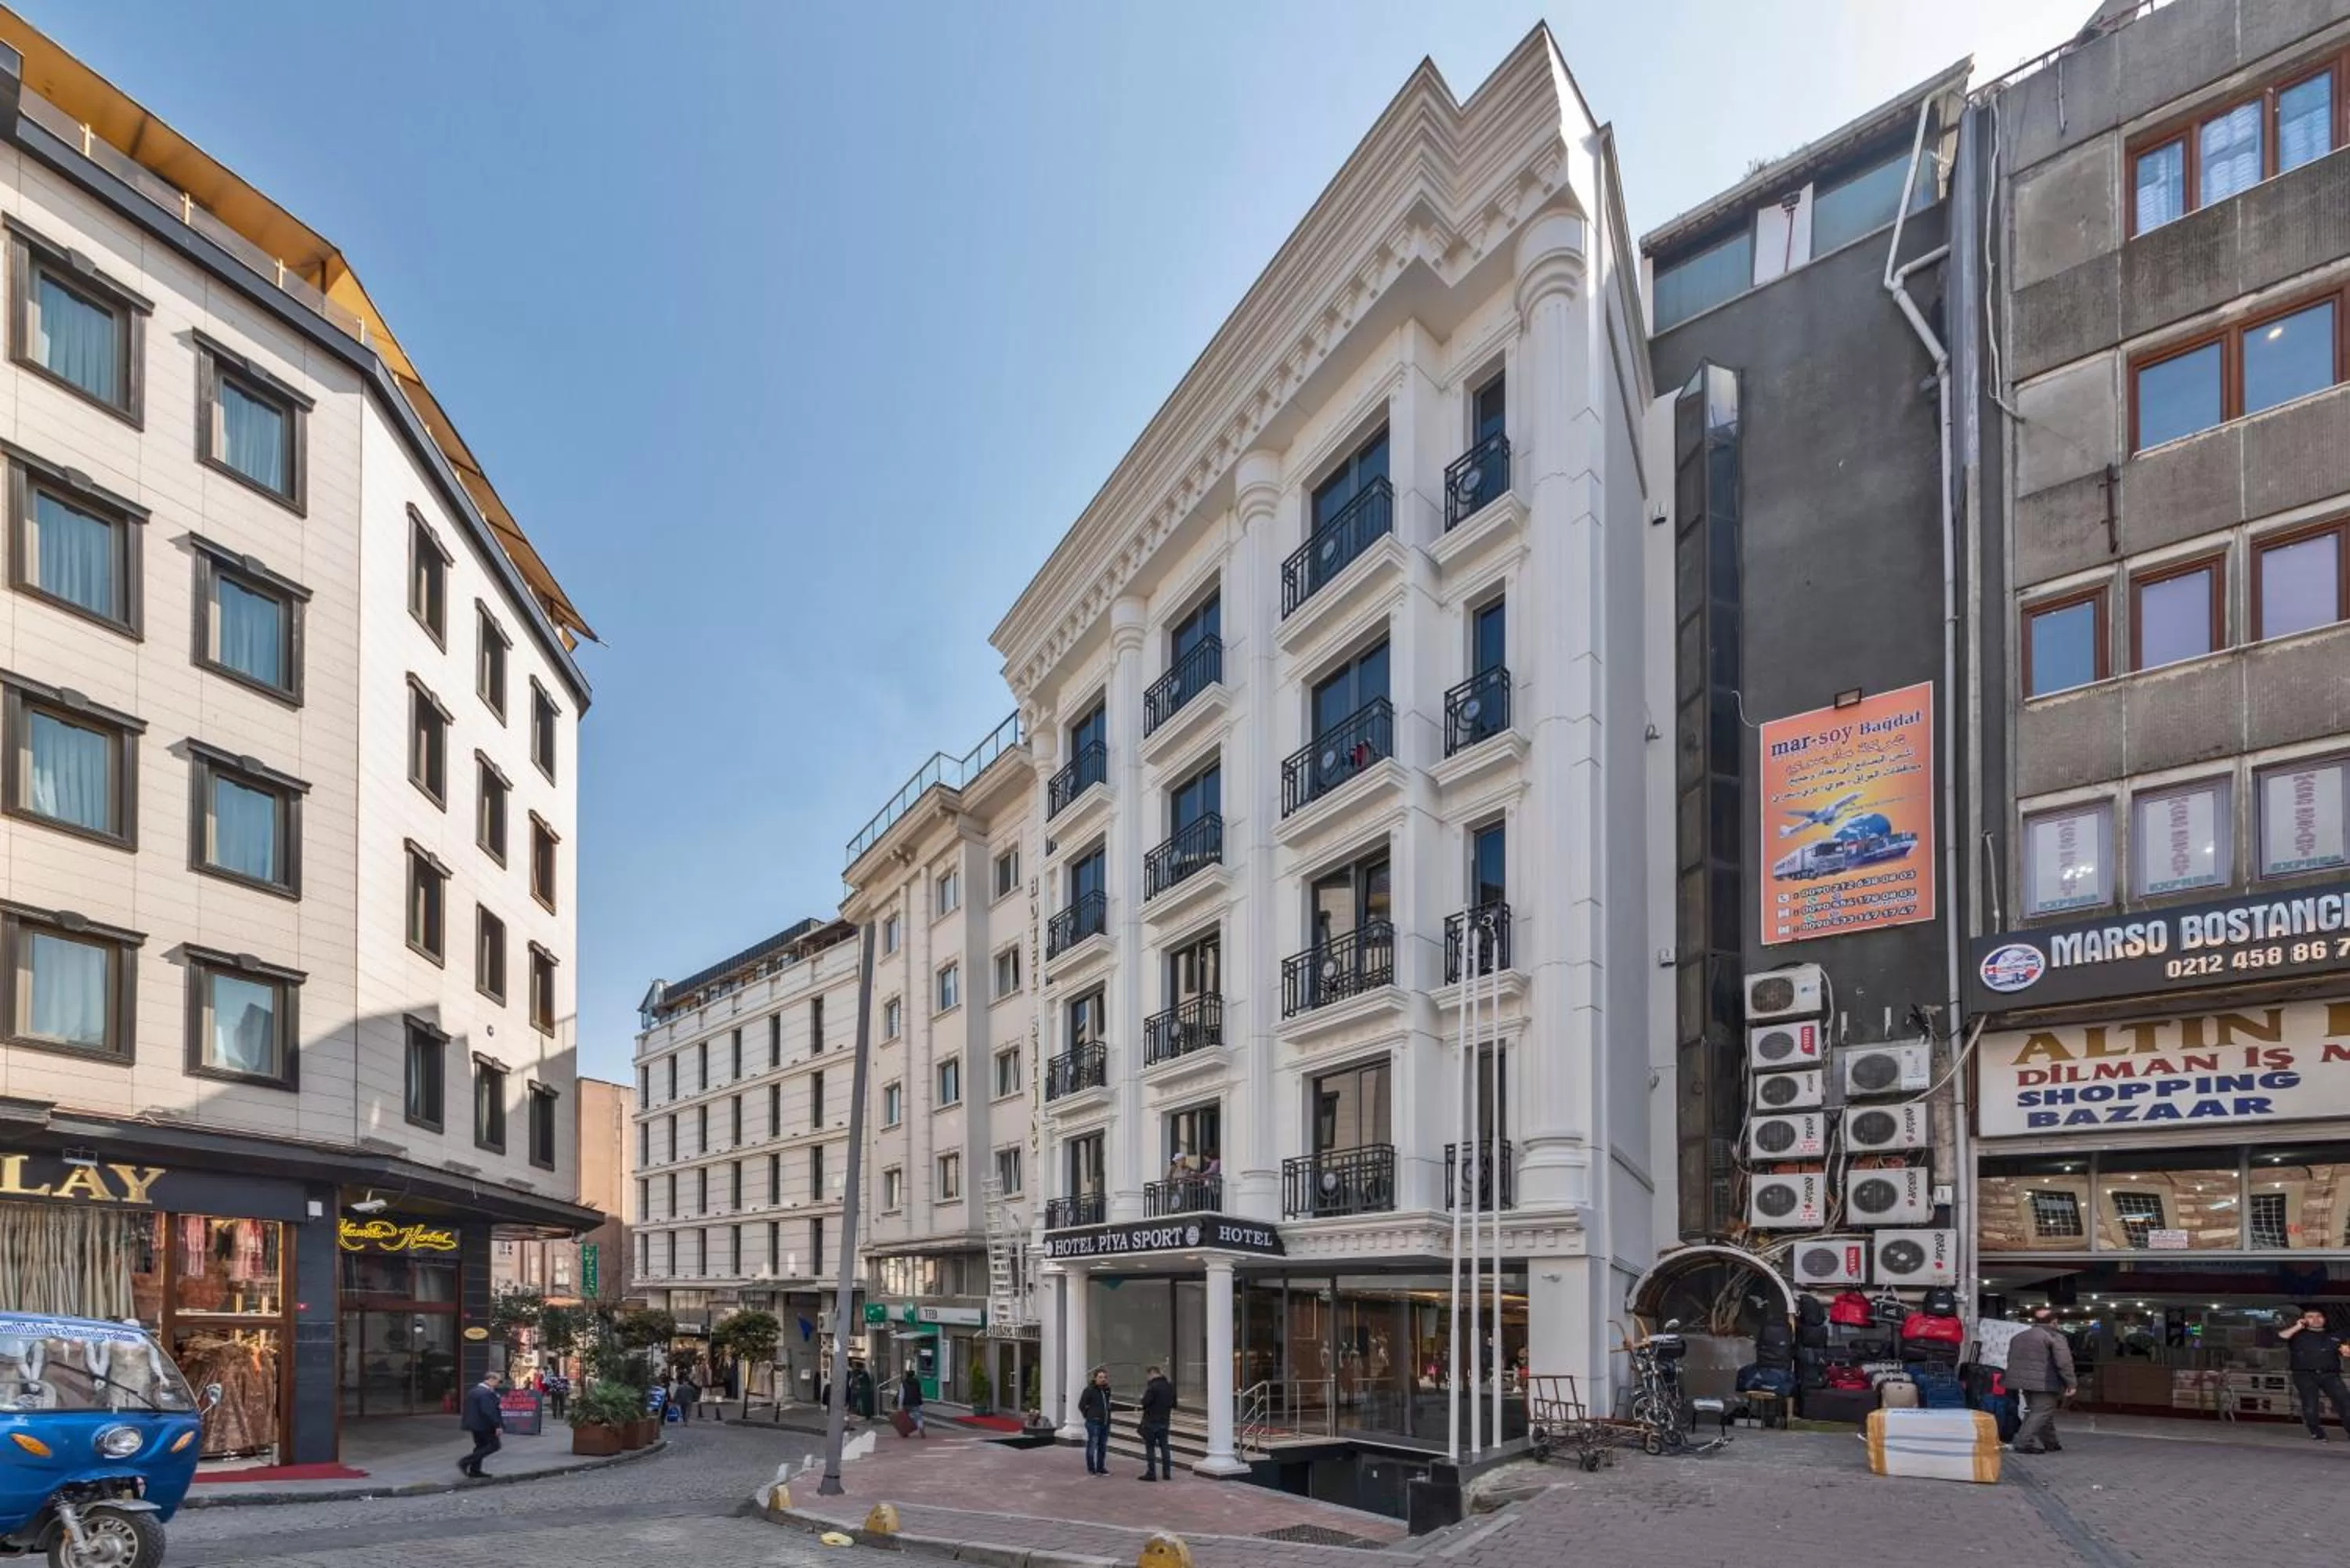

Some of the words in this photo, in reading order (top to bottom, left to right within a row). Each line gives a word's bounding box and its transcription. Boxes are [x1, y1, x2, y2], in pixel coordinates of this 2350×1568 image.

[1771, 726, 1853, 757] mar-soy
[2051, 919, 2168, 968] MARSO
[2166, 954, 2224, 978] 0212
[2232, 946, 2283, 970] 458
[2291, 940, 2327, 963] 86
[2011, 1008, 2284, 1065] ALTIN
[2018, 1053, 2218, 1086] DİLMAN
[2017, 1071, 2301, 1107] SHOPPING
[2028, 1097, 2275, 1128] BAZAAR
[0, 1153, 166, 1205] LAY
[1054, 1237, 1094, 1256] HOTEL
[1098, 1229, 1129, 1252] PİYA
[1132, 1227, 1184, 1248] SPORT
[1218, 1225, 1274, 1247] HOTEL
